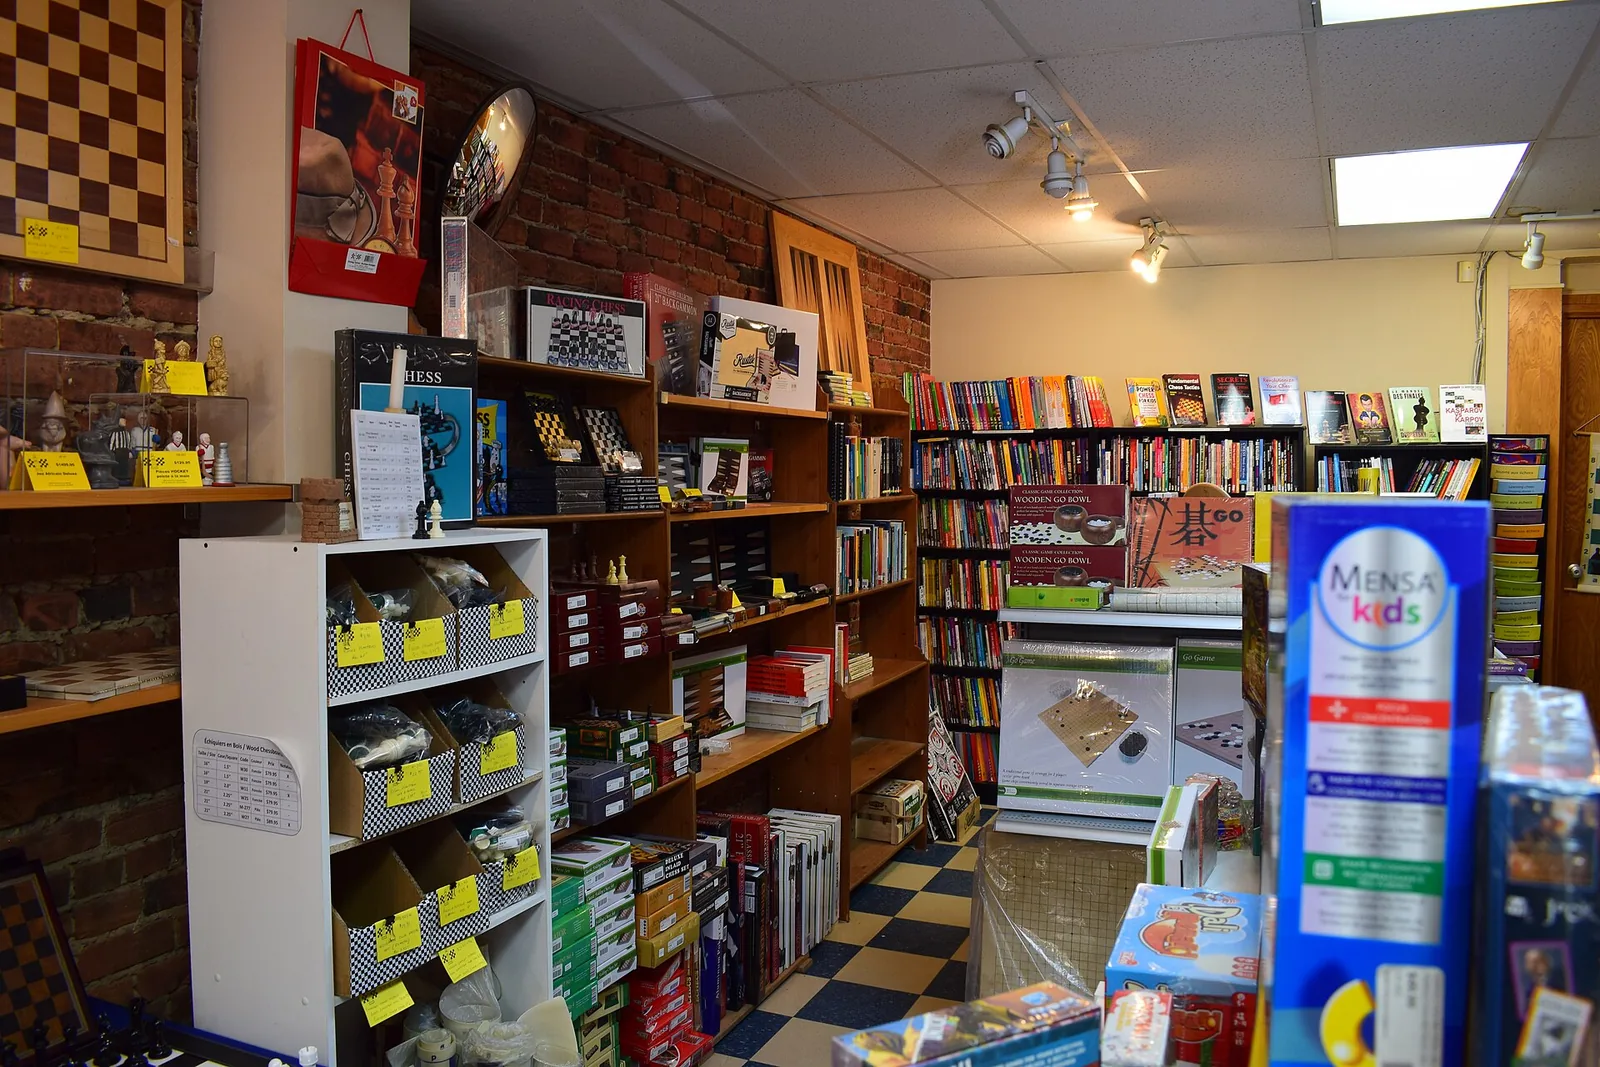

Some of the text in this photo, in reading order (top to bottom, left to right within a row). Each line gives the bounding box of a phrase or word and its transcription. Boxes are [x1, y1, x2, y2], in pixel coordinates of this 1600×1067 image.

[654, 283, 668, 294] CLASSIC
[546, 293, 626, 314] RACING CHESS
[662, 296, 698, 316] BACKGAMMON
[404, 370, 442, 384] HESS
[1169, 500, 1218, 546] 碁
[1213, 510, 1243, 523] GO
[1330, 564, 1436, 594] MENSA
[1353, 596, 1420, 631] kids
[1010, 657, 1036, 666] Go Game
[1182, 654, 1192, 662] Go
[735, 833, 744, 849] 21"
[665, 853, 683, 865] DELUXE
[665, 861, 682, 872] INLAID
[665, 864, 689, 879] CHESS SET
[651, 1025, 669, 1041] Chess
